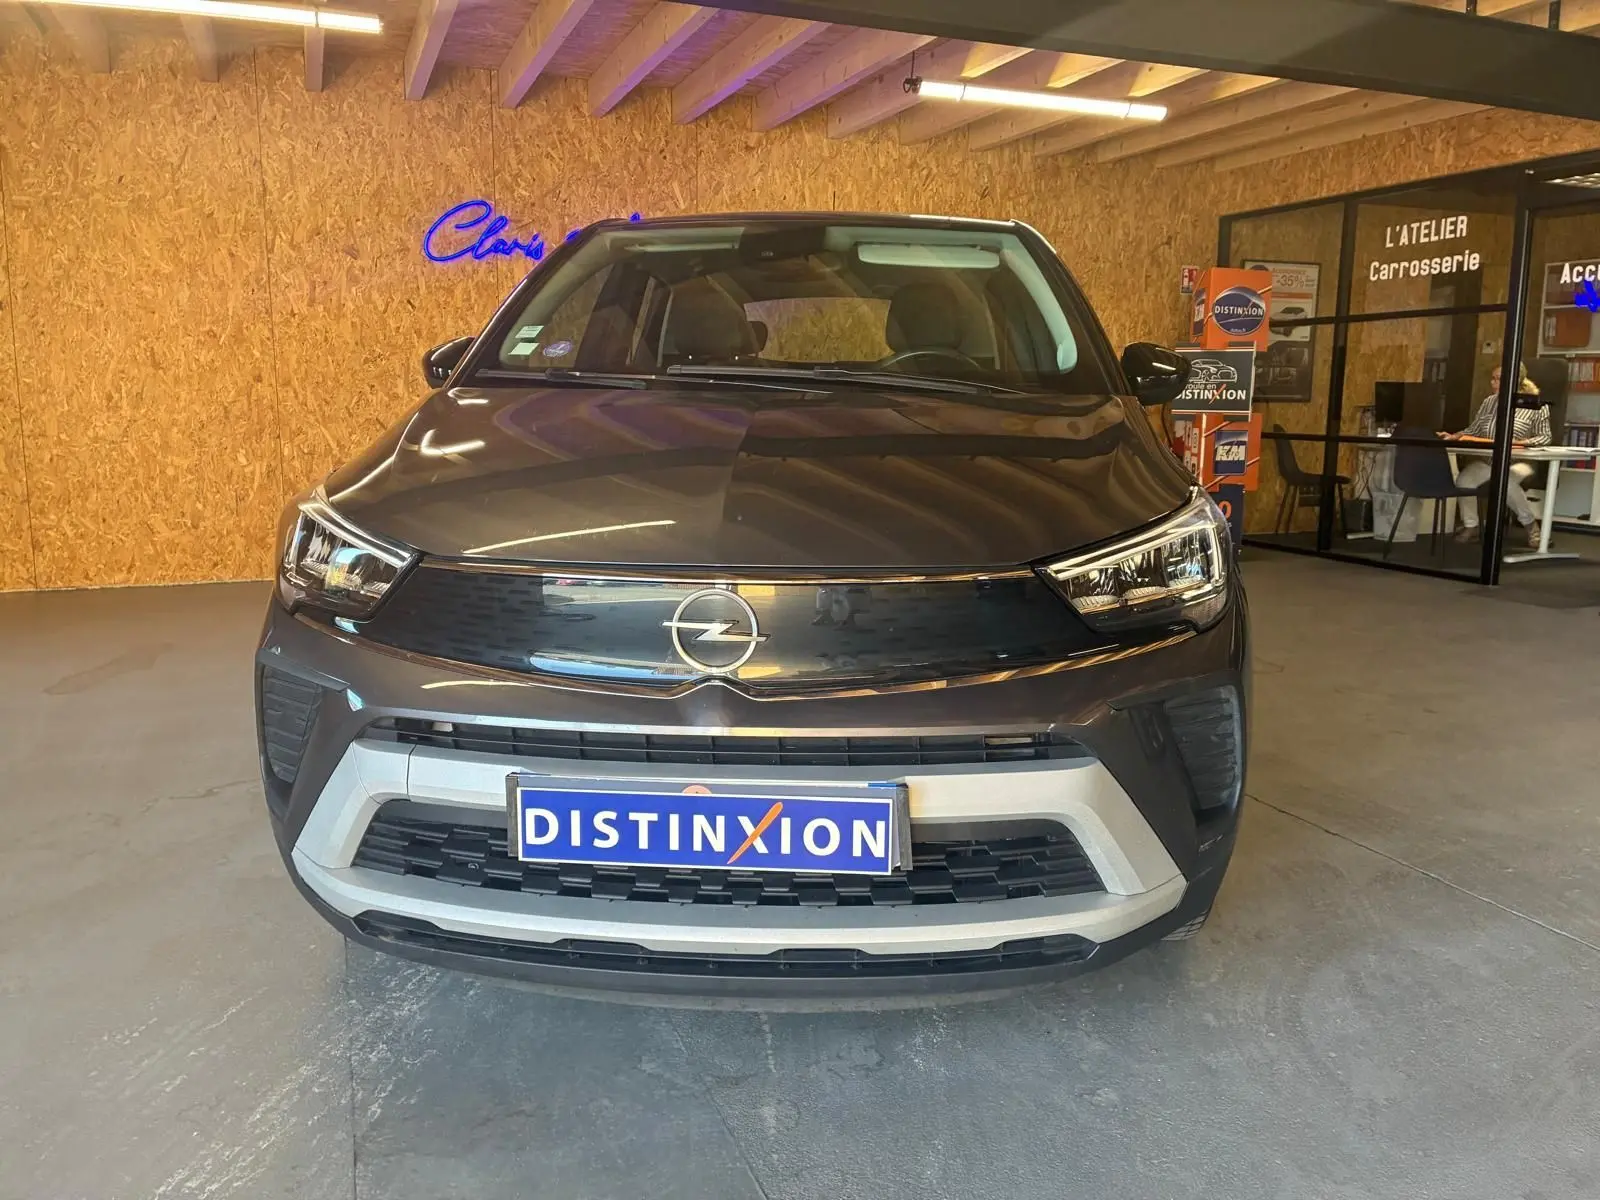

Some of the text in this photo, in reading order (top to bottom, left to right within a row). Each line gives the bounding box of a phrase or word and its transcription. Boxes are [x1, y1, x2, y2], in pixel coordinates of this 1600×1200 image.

[1385, 215, 1468, 248] L'ATELIER
[1369, 249, 1480, 281] Carrosserie
[1214, 302, 1264, 317] DISTINXION
[524, 802, 886, 864] DISTINXION
